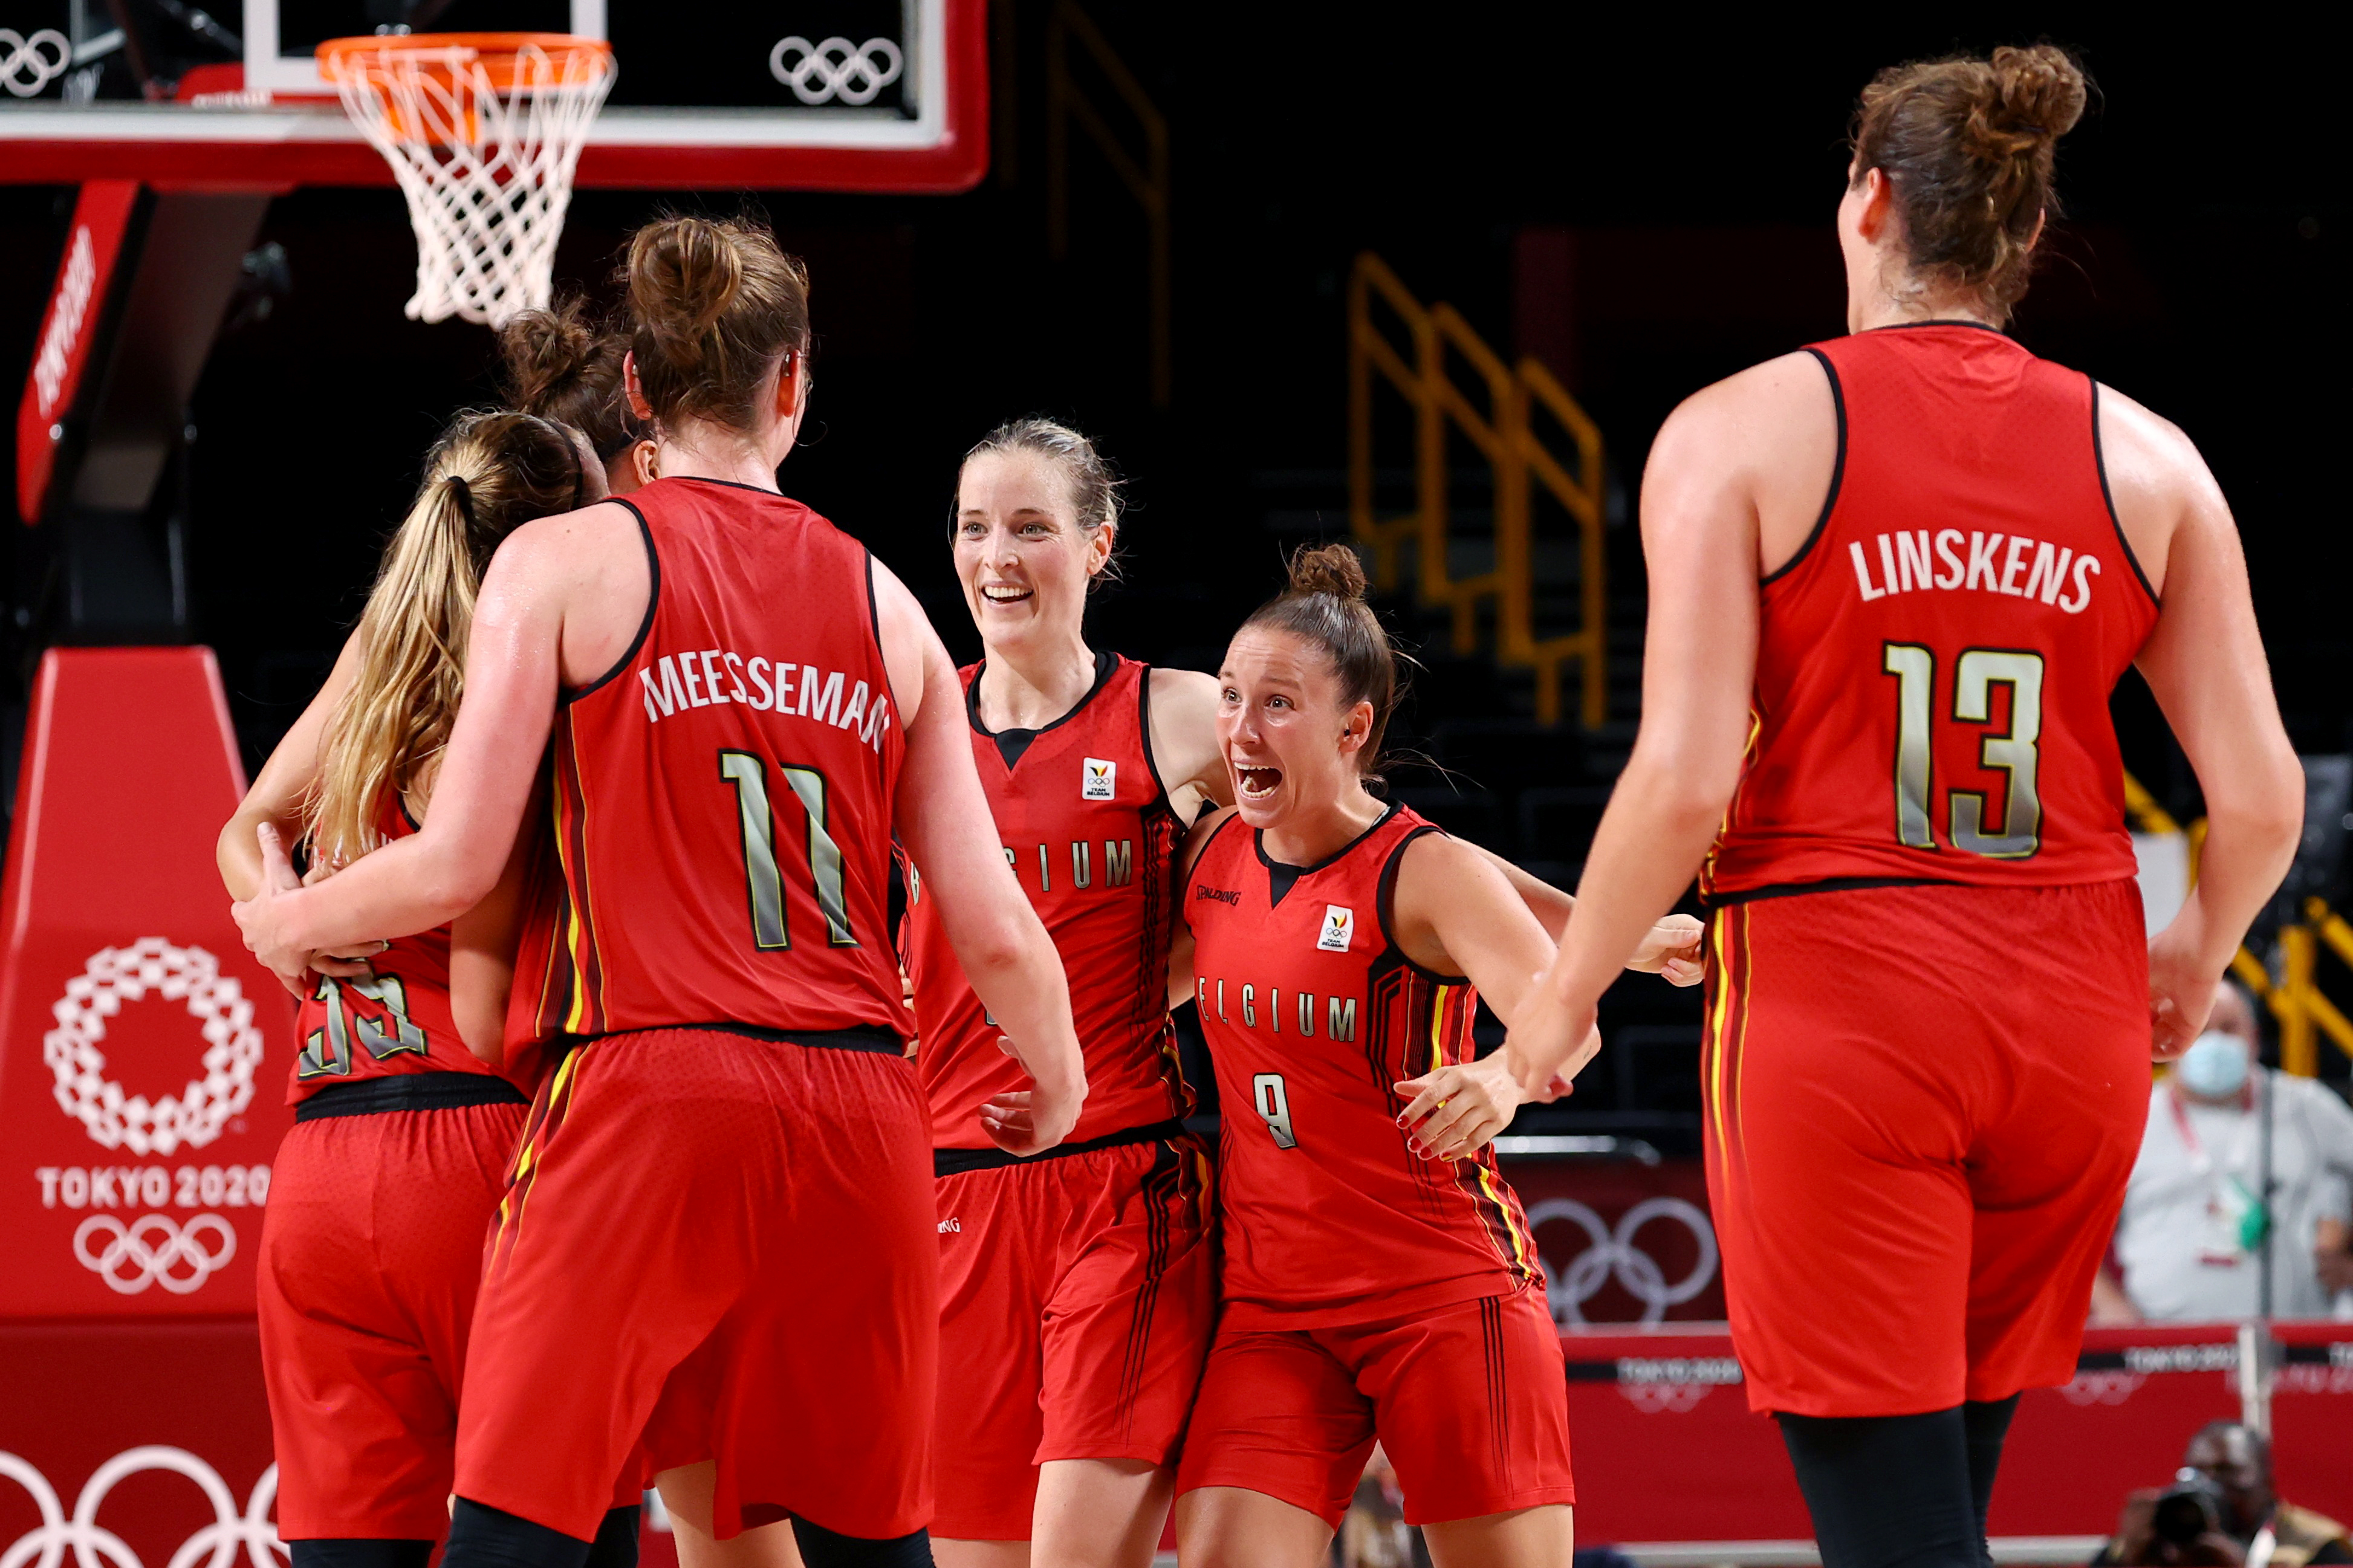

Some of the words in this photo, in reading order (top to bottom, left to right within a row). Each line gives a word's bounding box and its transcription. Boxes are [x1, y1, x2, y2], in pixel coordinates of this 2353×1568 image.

[1849, 529, 2100, 614] LINSKENS
[638, 649, 890, 754] MEESSEMAN
[1883, 640, 2044, 859] 13
[718, 748, 861, 951] 11
[1196, 885, 1242, 907] SPALDING
[1253, 1072, 1297, 1150] 9
[34, 1165, 170, 1209] TOKYO
[174, 1164, 272, 1208] 2020
